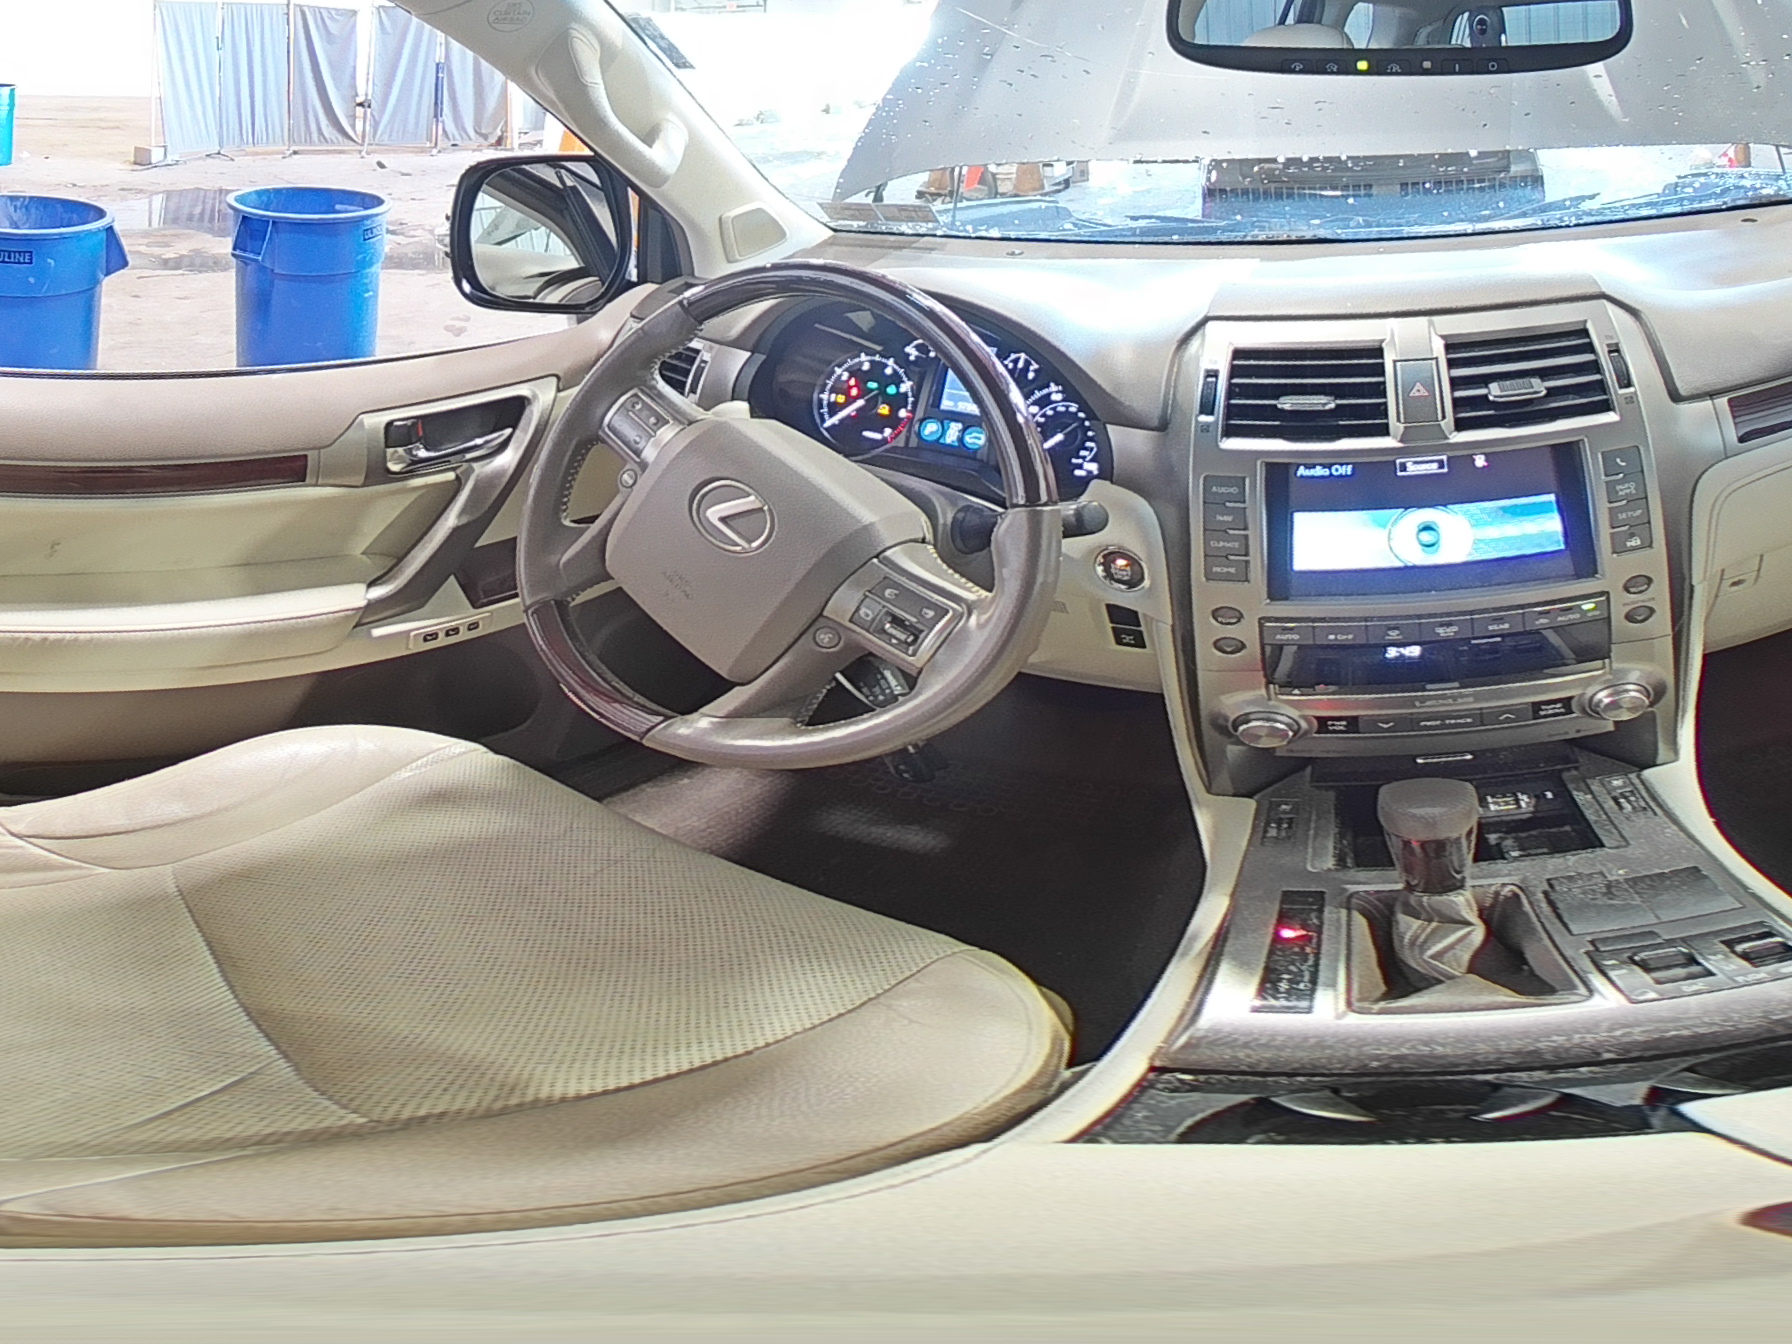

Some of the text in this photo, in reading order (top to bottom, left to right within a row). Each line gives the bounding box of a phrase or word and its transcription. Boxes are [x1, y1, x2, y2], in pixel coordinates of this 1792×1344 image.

[1296, 464, 1354, 478] Audio Off
[1211, 485, 1240, 493] AUDIO
[1617, 509, 1643, 520] SETUP
[1384, 645, 1422, 659] 3:49
